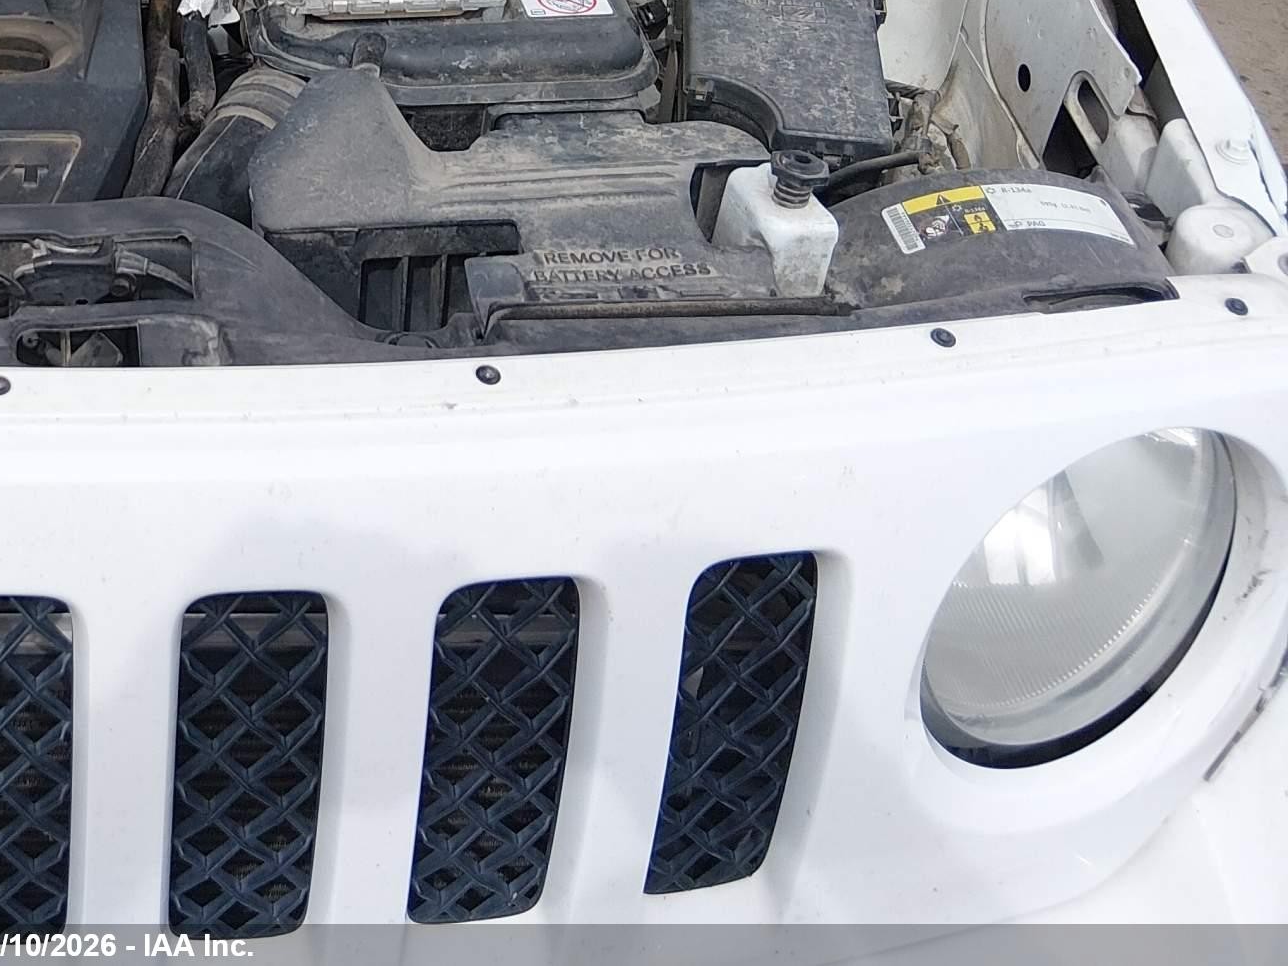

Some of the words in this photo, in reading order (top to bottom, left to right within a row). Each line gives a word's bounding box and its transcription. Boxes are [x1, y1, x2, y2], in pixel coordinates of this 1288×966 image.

[543, 249, 632, 265] REMOVE
[636, 247, 680, 262] FOR
[533, 268, 622, 284] BATTERY
[630, 262, 712, 281] ACCESS
